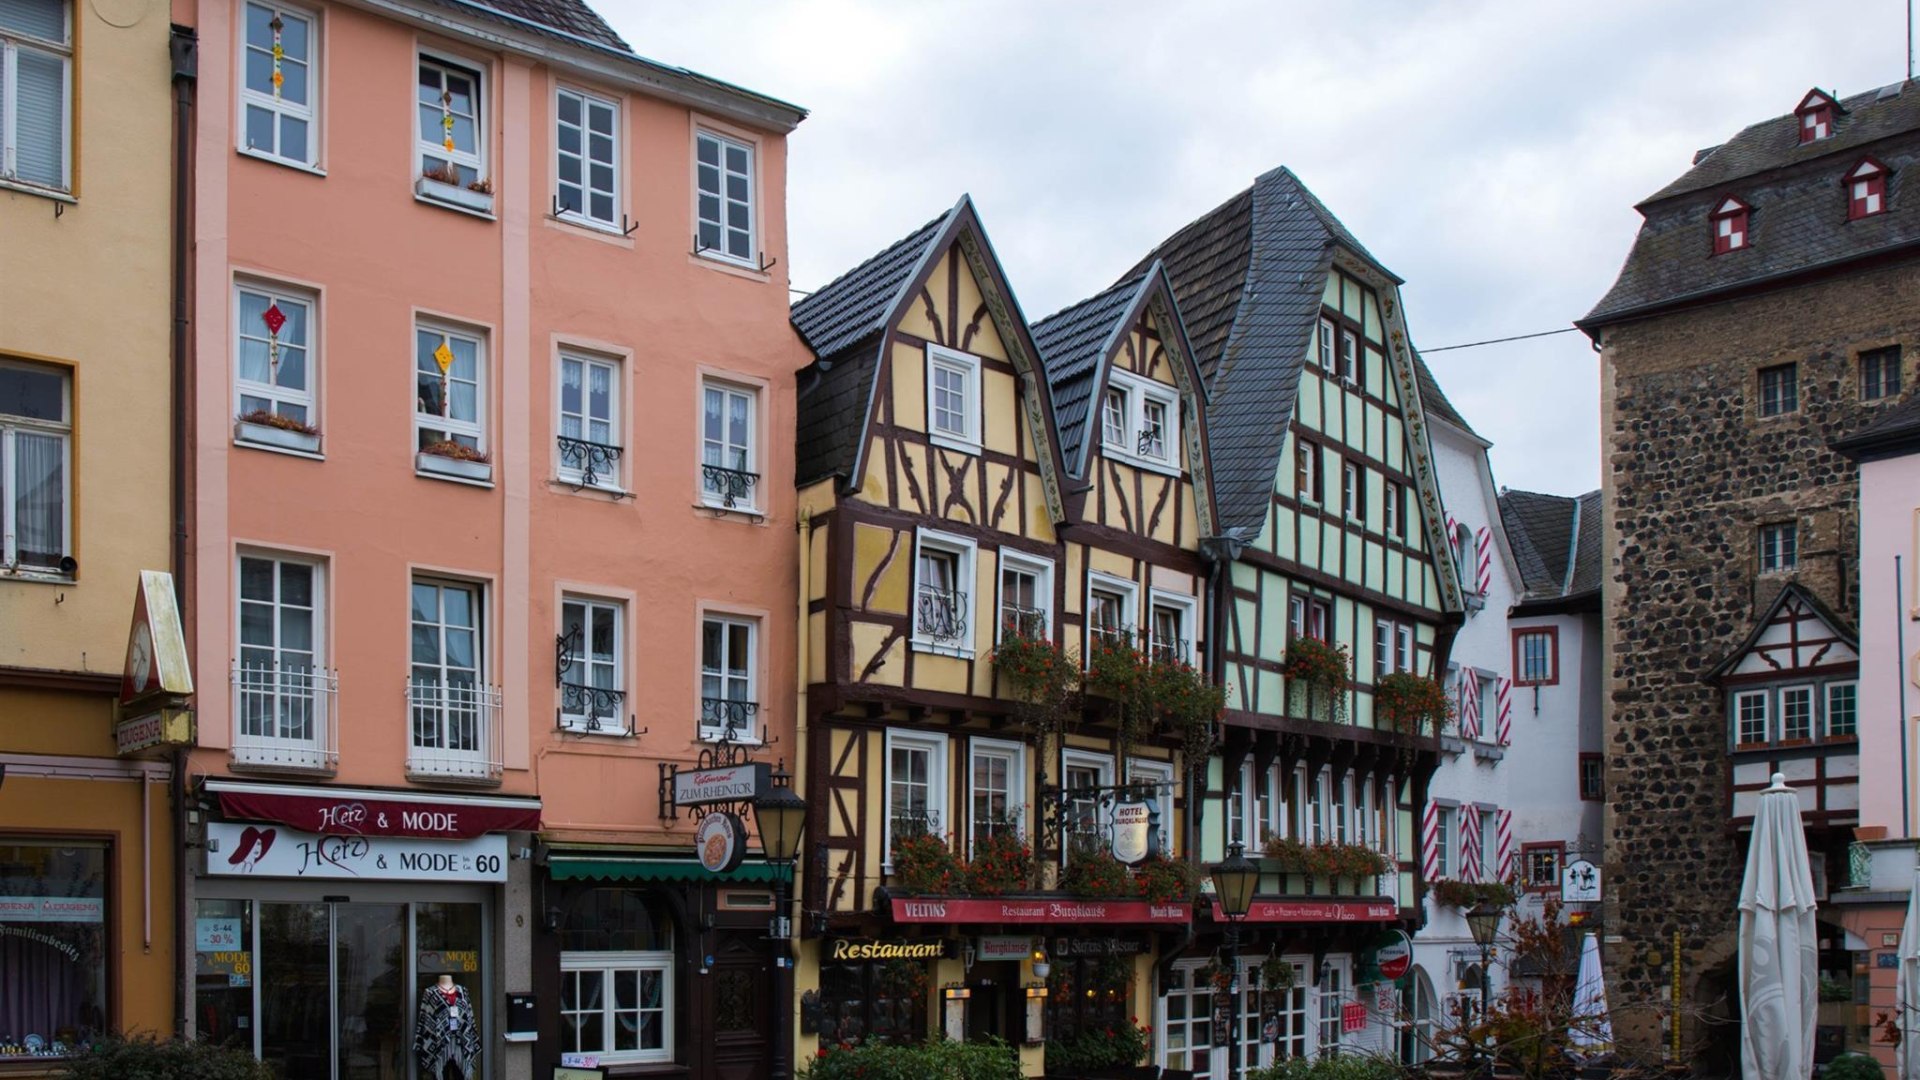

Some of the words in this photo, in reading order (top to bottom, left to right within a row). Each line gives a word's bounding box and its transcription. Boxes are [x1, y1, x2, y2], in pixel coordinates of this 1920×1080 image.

[119, 719, 161, 747] DUGENA
[693, 770, 736, 787] Restaurant
[680, 788, 701, 801] ZUM
[702, 782, 752, 799] RHEINTOR
[1119, 807, 1143, 817] HOTEL
[377, 812, 389, 828] &
[402, 811, 458, 832] MODE
[296, 838, 365, 875] Herz
[376, 853, 388, 870] &
[400, 852, 458, 872] MODE
[476, 854, 500, 873] 60
[904, 902, 946, 918] VELTINS
[1002, 905, 1045, 917] Restaurant
[1050, 903, 1105, 920] Burgklause
[214, 952, 250, 963] MODE
[446, 951, 477, 962] MODE
[833, 939, 944, 960] Restaurant
[234, 963, 250, 974] 60
[463, 961, 477, 972] 60
